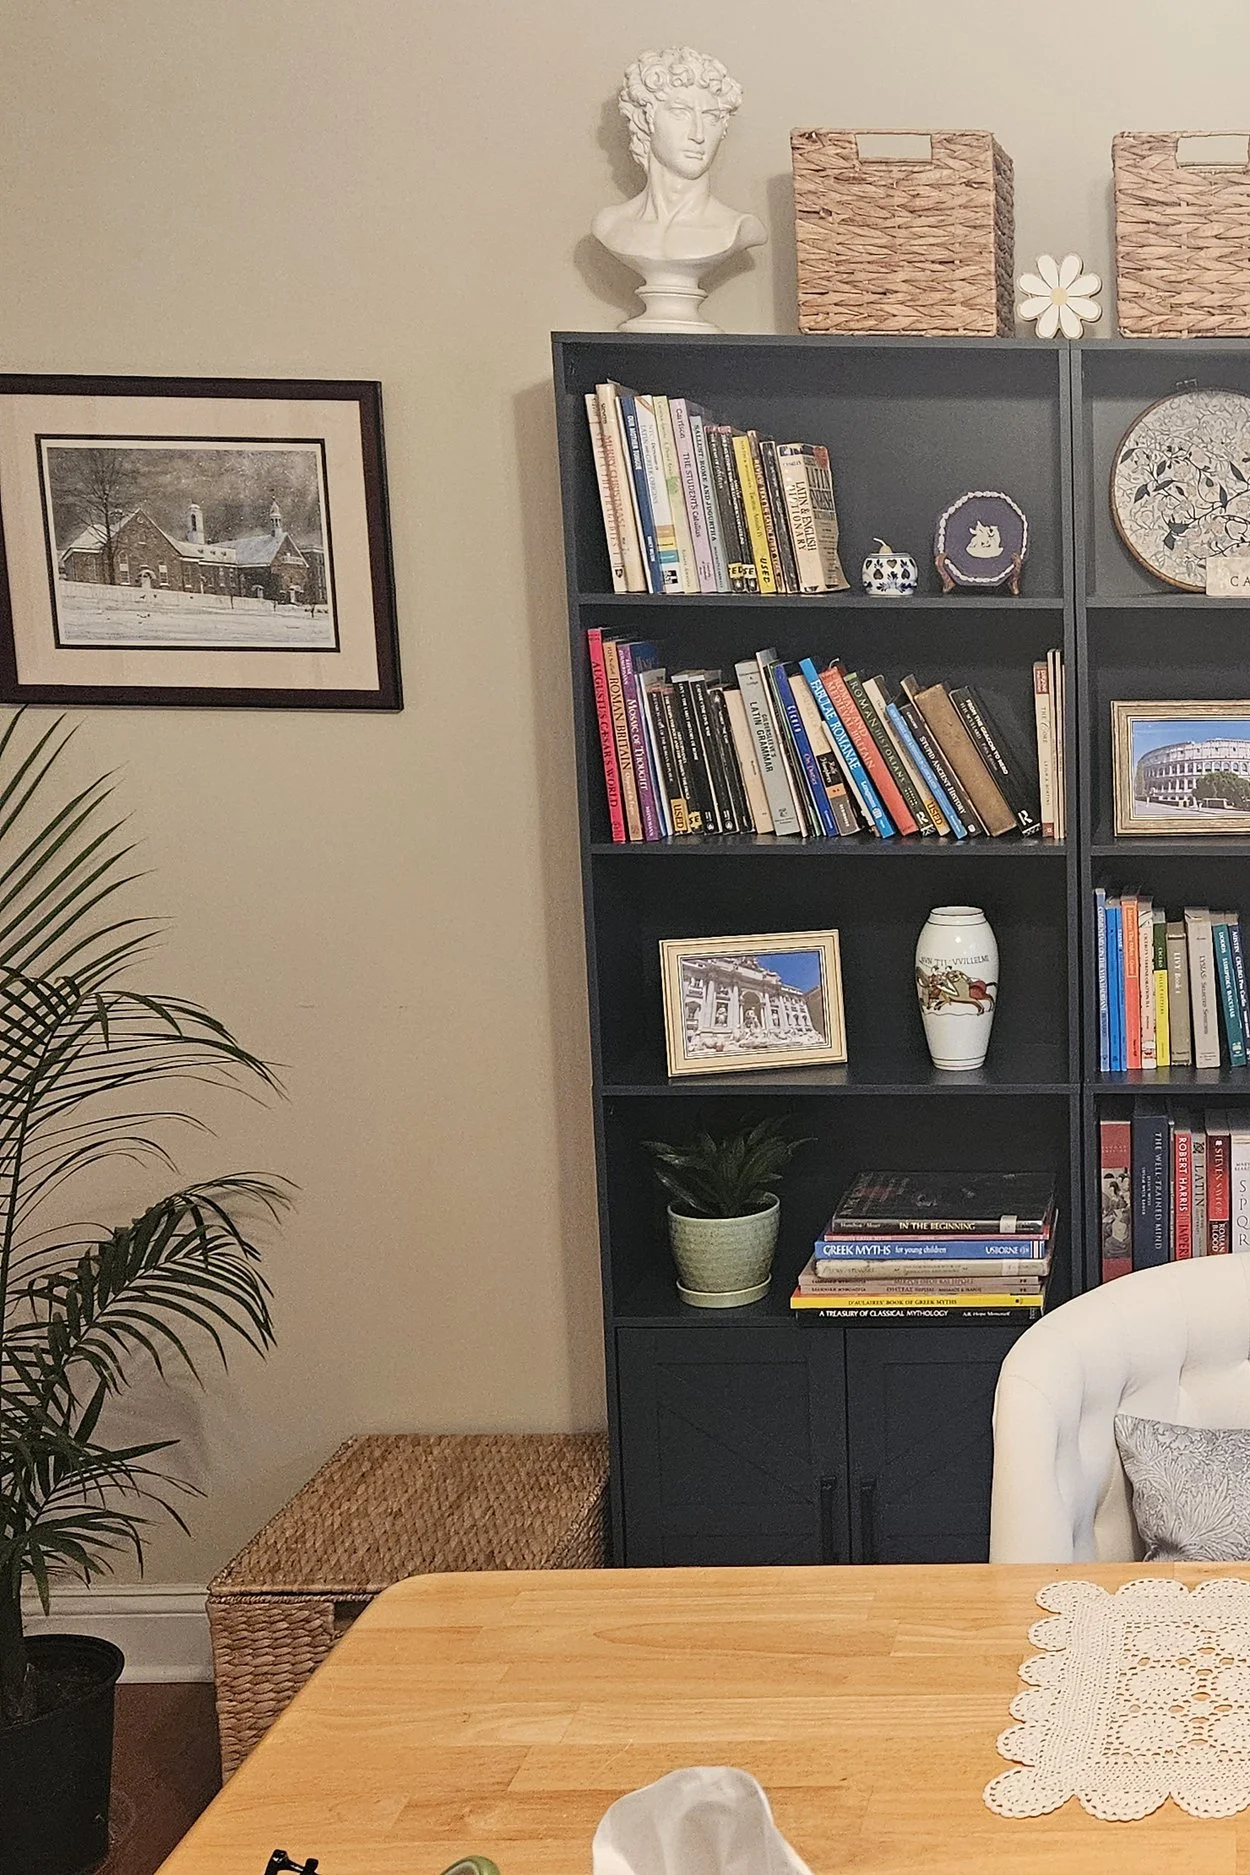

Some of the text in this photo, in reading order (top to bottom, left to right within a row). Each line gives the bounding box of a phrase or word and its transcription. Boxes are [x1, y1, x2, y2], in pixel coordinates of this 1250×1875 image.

[795, 480, 816, 551] LATIN & ENGLISH
[759, 555, 770, 582] USED
[848, 679, 879, 730] ROMAN
[608, 676, 630, 770] ROMAN BRITAIN
[749, 700, 773, 773] LATIN GRAMMAR
[809, 678, 861, 771] FABULAE ROMANAE
[852, 714, 868, 738] AND
[964, 697, 1009, 776] FROM THE GRACCHI TO NERO
[918, 734, 967, 816] STUPID ANCIENT HISTORY
[673, 804, 685, 829] USED
[925, 800, 944, 827] USED
[1172, 952, 1181, 970] LIVY
[1198, 955, 1207, 978] LYSIAS
[1178, 1137, 1187, 1211] ROBERT HARRIS
[1214, 1148, 1222, 1180] STEVEN
[1153, 1153, 1162, 1220] WELL-TRAINED
[1194, 1164, 1204, 1207] LATIN
[911, 1222, 929, 1230] THE
[930, 1222, 976, 1230] BEGINNING
[1154, 1223, 1162, 1249] MIND
[1217, 1223, 1225, 1253] ROMAN
[823, 1245, 854, 1255] GREEK
[855, 1245, 891, 1255] MYTHS
[904, 1247, 922, 1256] young
[923, 1245, 947, 1253] children
[985, 1246, 1018, 1254] USBORNE
[859, 1309, 869, 1317] OF
[869, 1309, 905, 1317] CLASSICAL
